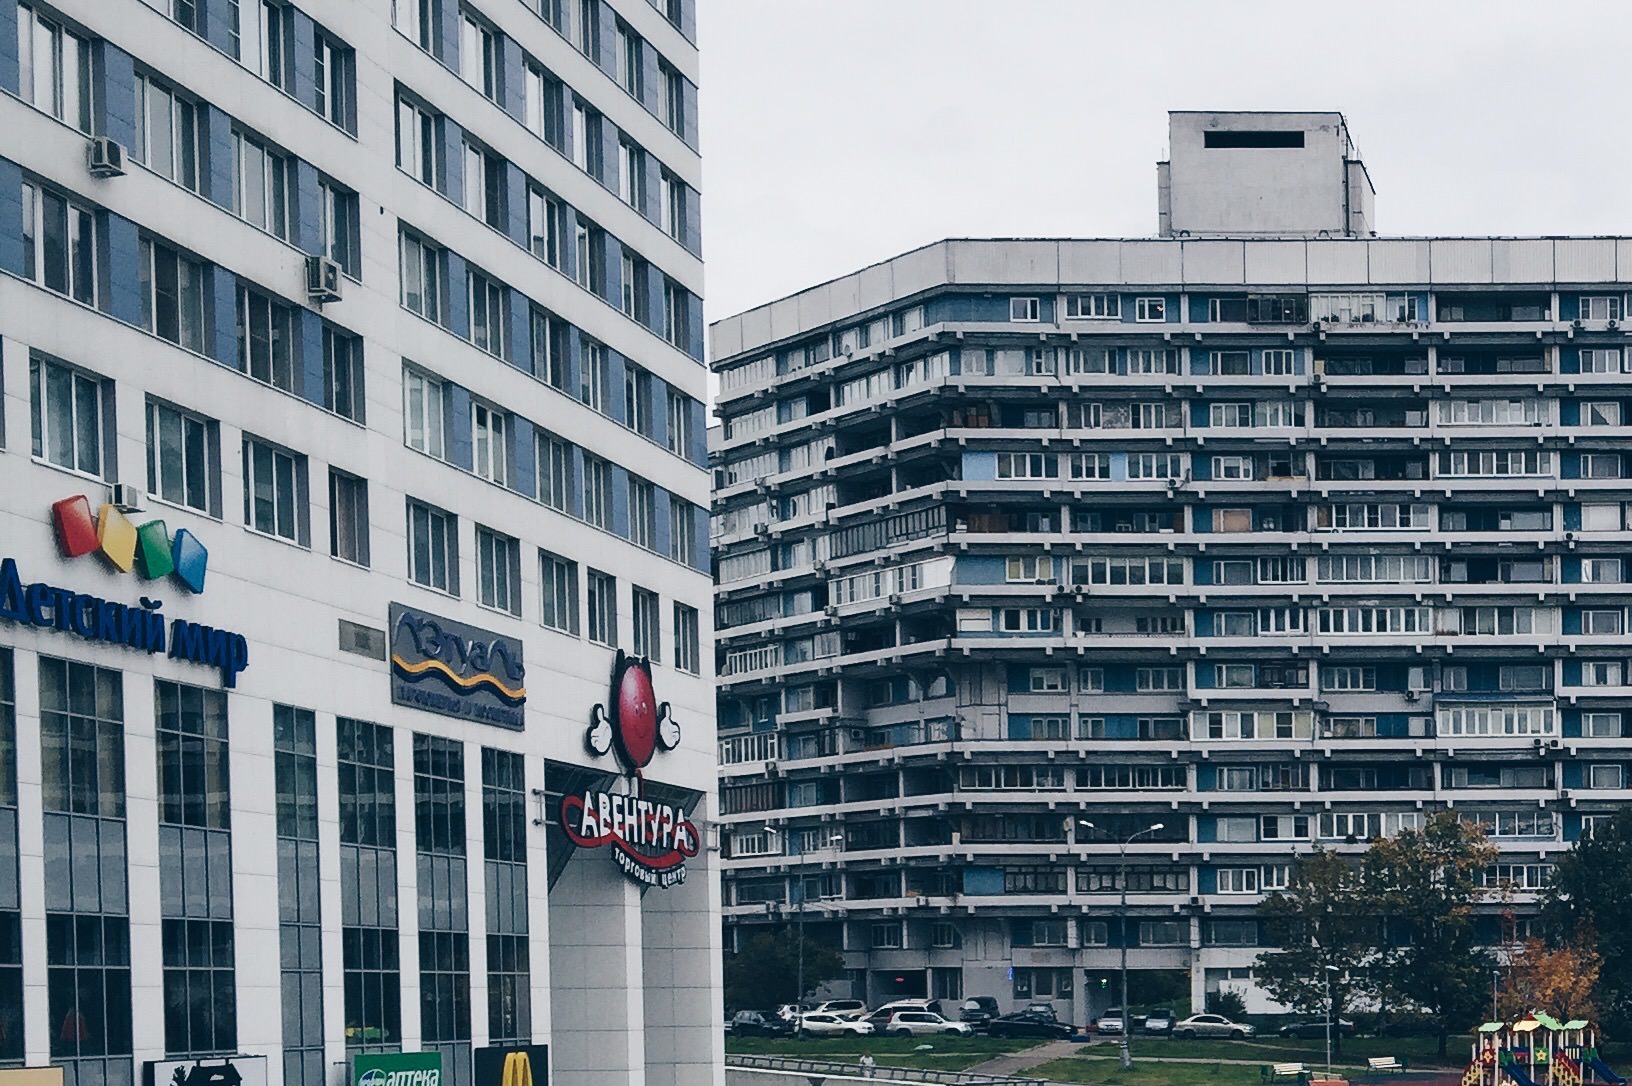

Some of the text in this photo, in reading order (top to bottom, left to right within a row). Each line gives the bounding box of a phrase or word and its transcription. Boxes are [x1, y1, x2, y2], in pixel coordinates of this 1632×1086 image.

[0, 558, 249, 688] Детский мир
[581, 790, 689, 850] АВЕНТУРА
[614, 847, 686, 888] торговый центр
